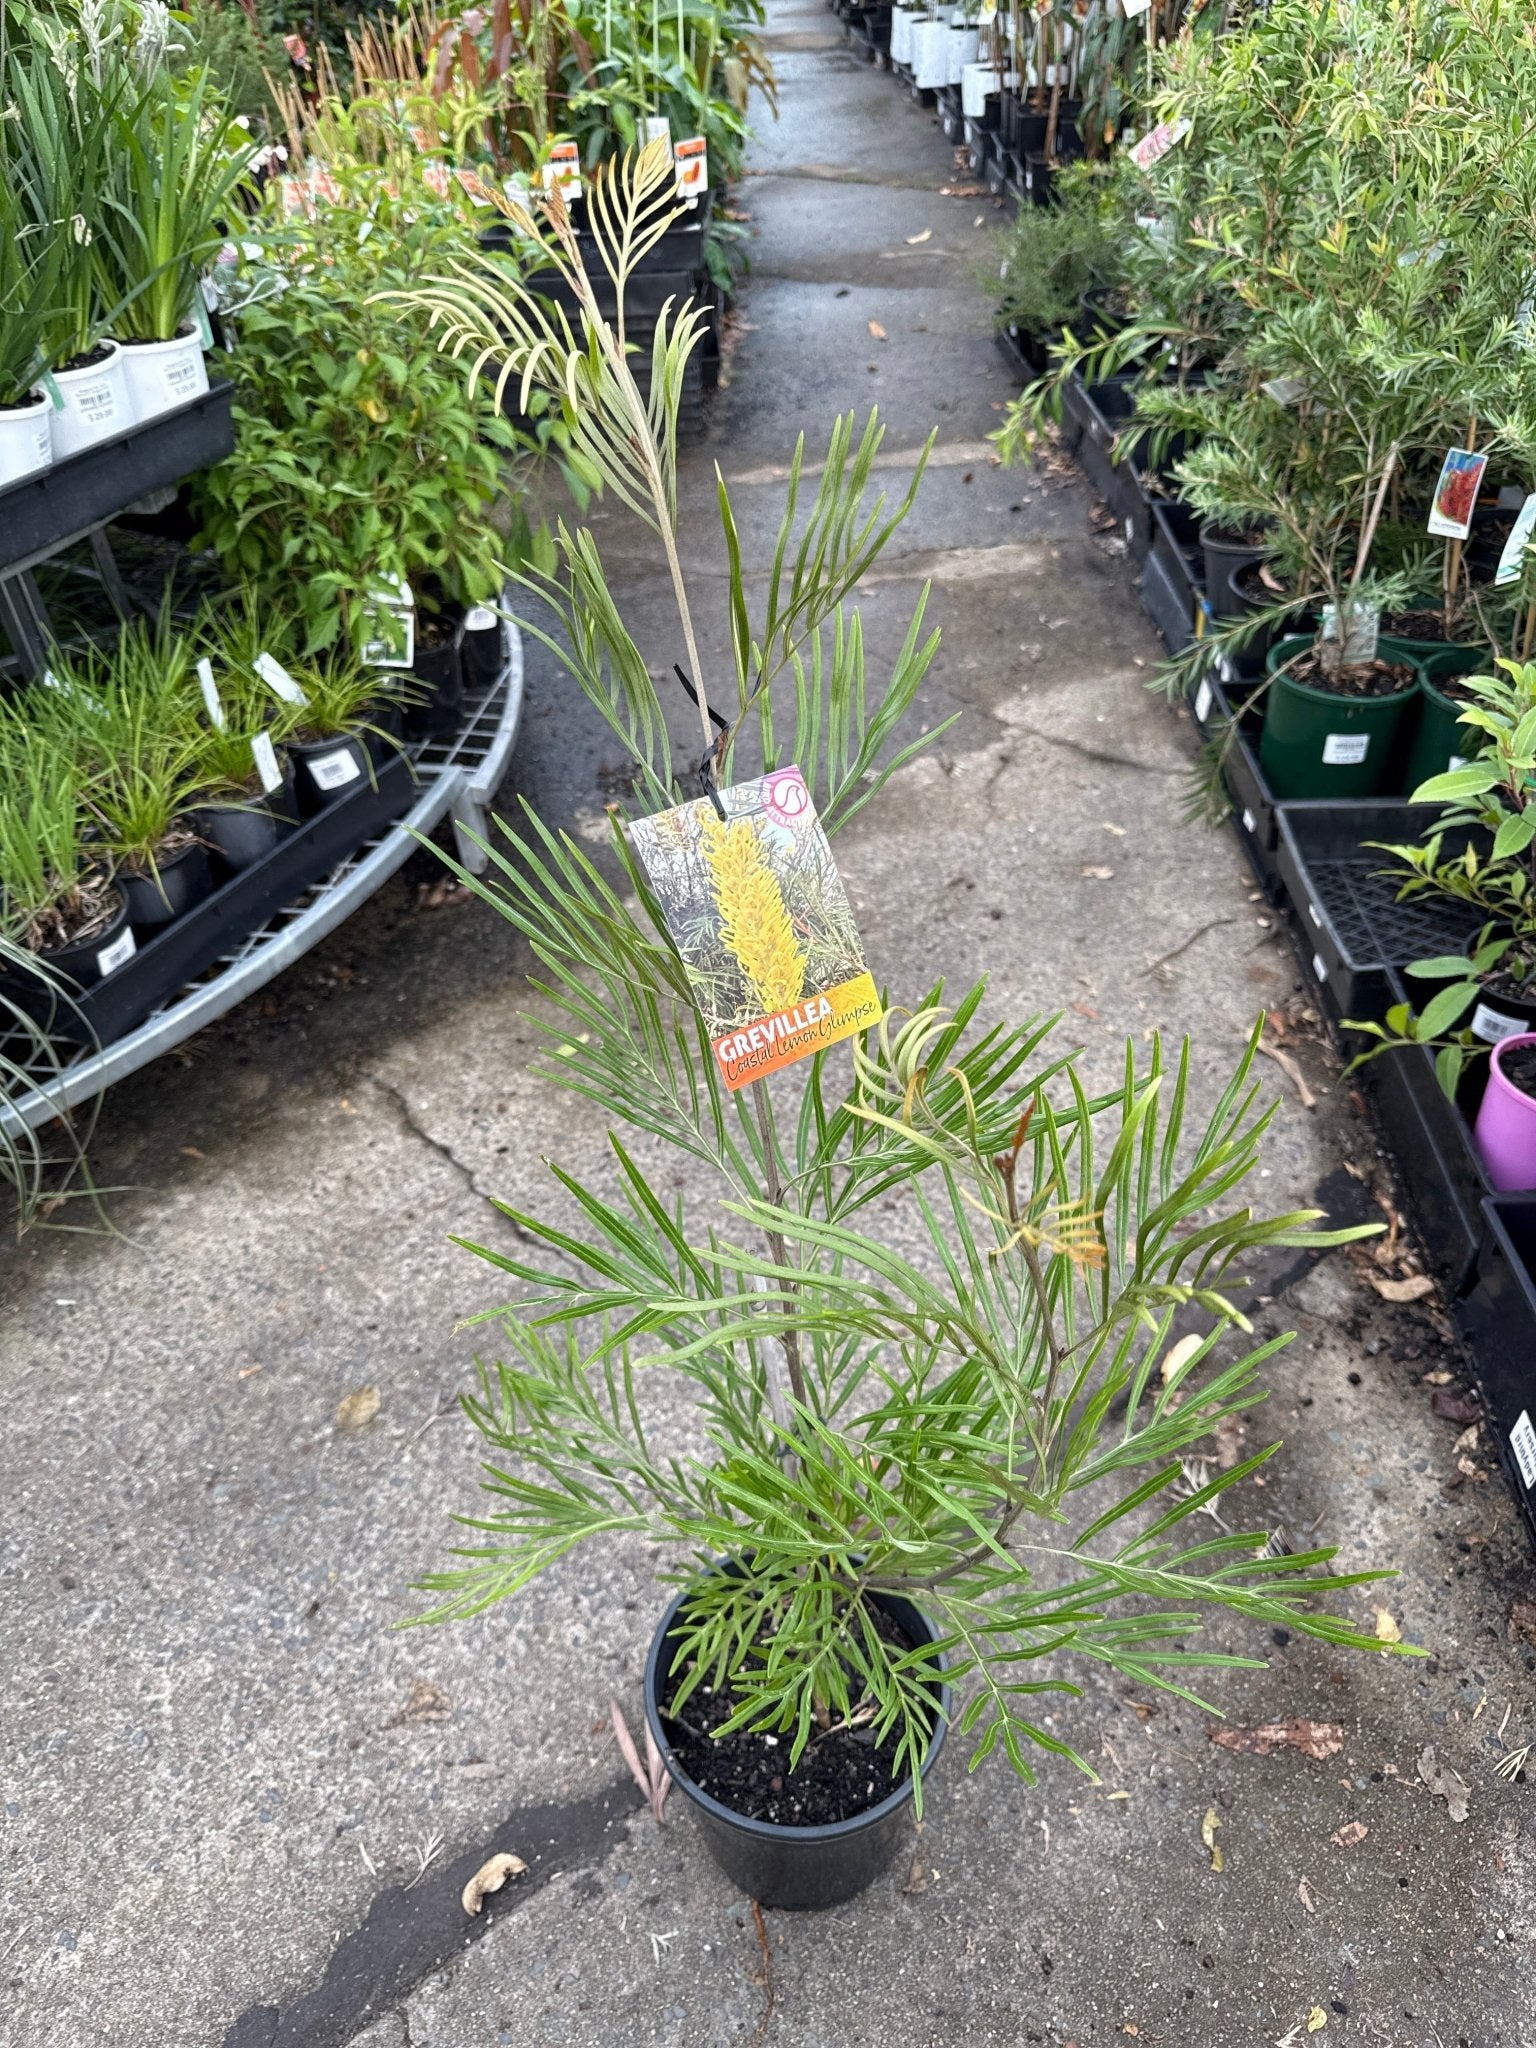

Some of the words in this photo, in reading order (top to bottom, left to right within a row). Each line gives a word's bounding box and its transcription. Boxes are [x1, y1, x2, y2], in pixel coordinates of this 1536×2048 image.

[719, 996, 833, 1063] GREVILLEA
[726, 1039, 774, 1081] Coastal
[775, 1030, 817, 1057] Lemon
[818, 1000, 876, 1040] Glimpse
[1515, 1433, 1535, 1484] Ladybird
